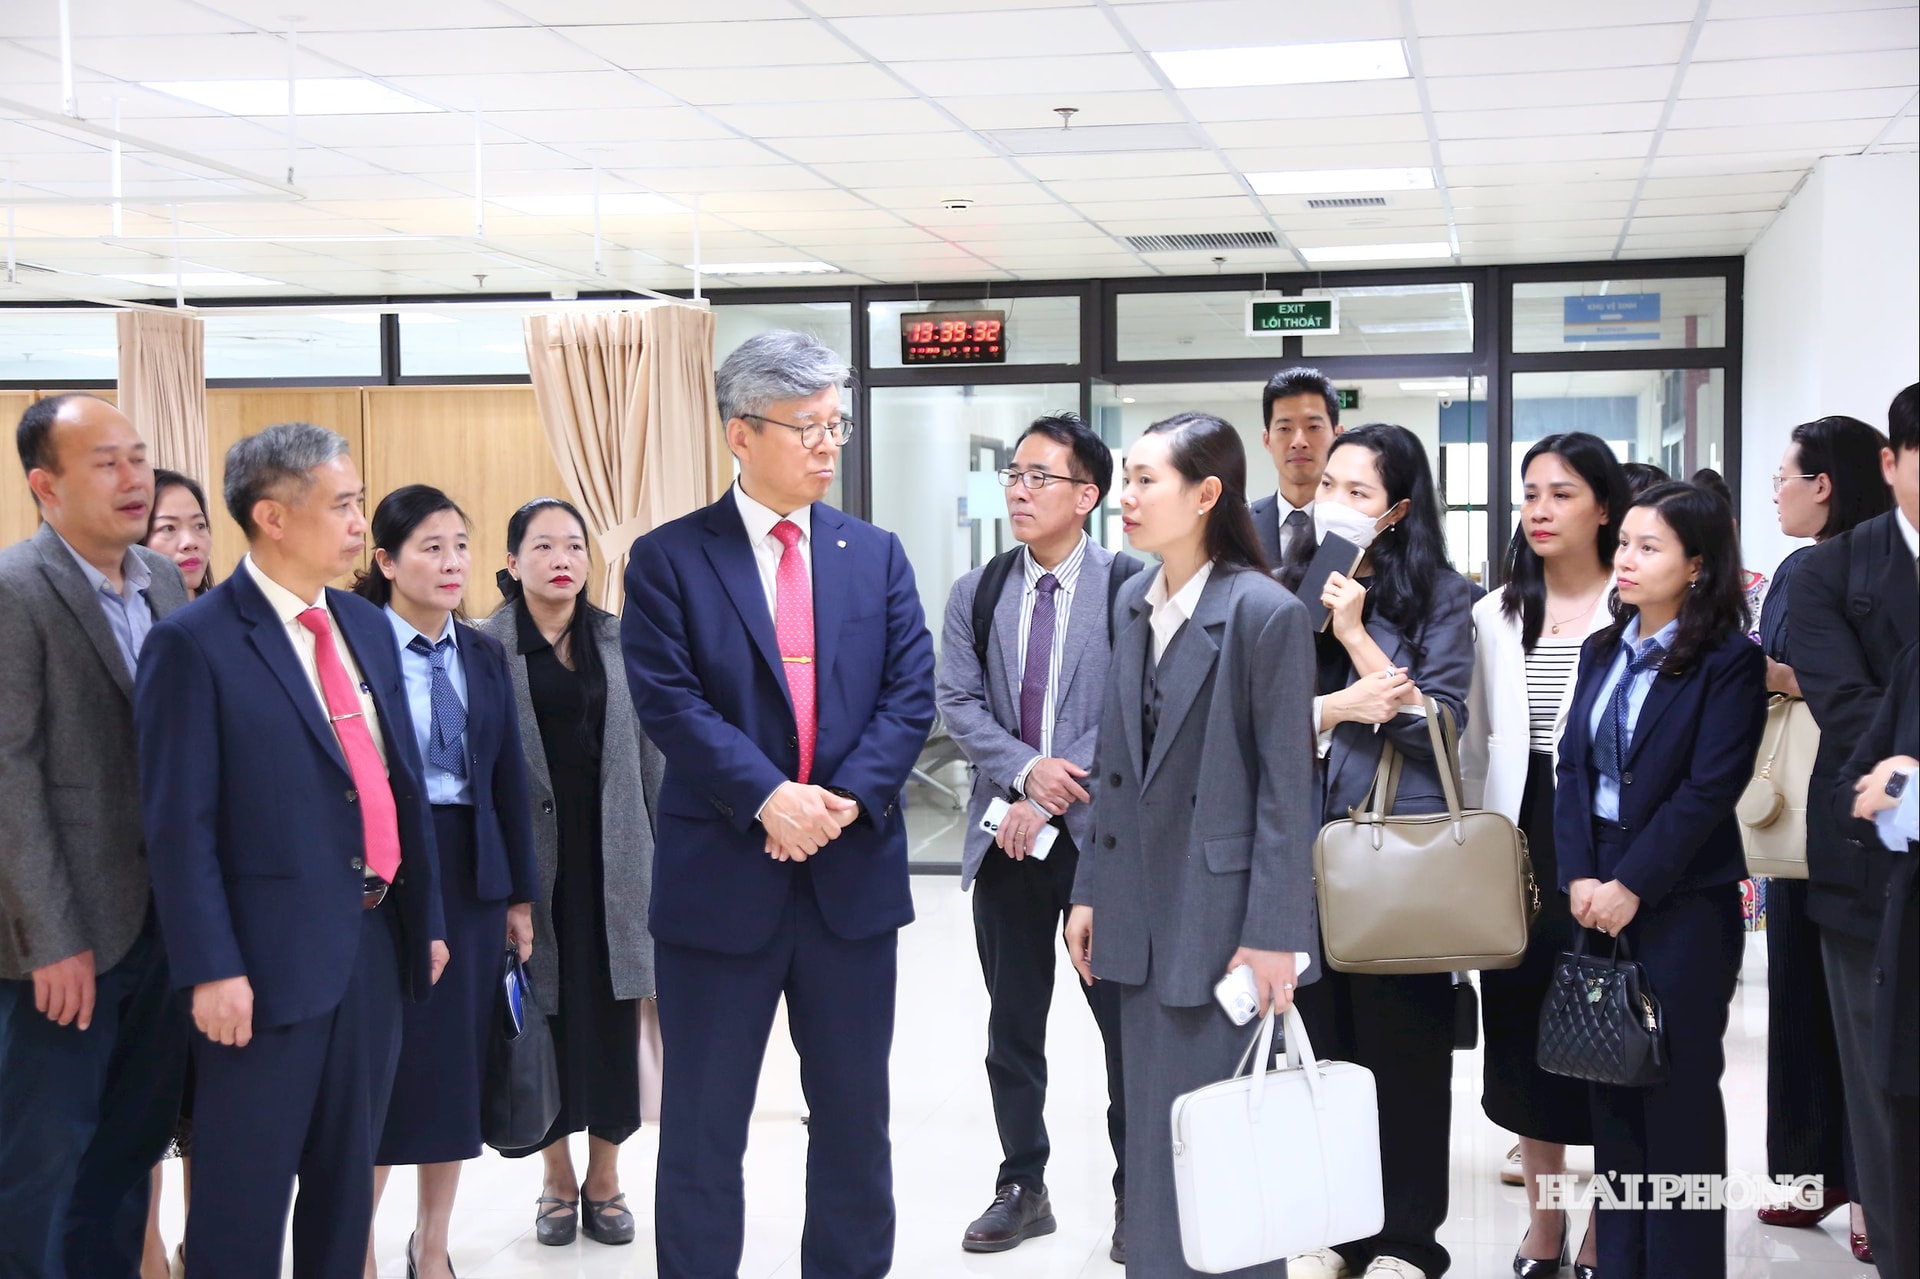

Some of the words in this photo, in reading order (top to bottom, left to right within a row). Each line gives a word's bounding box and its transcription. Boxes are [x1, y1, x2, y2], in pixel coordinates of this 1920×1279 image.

[1279, 304, 1305, 314] EXIT
[1283, 314, 1323, 328] THOÁT
[911, 320, 1001, 343] 13:39:32
